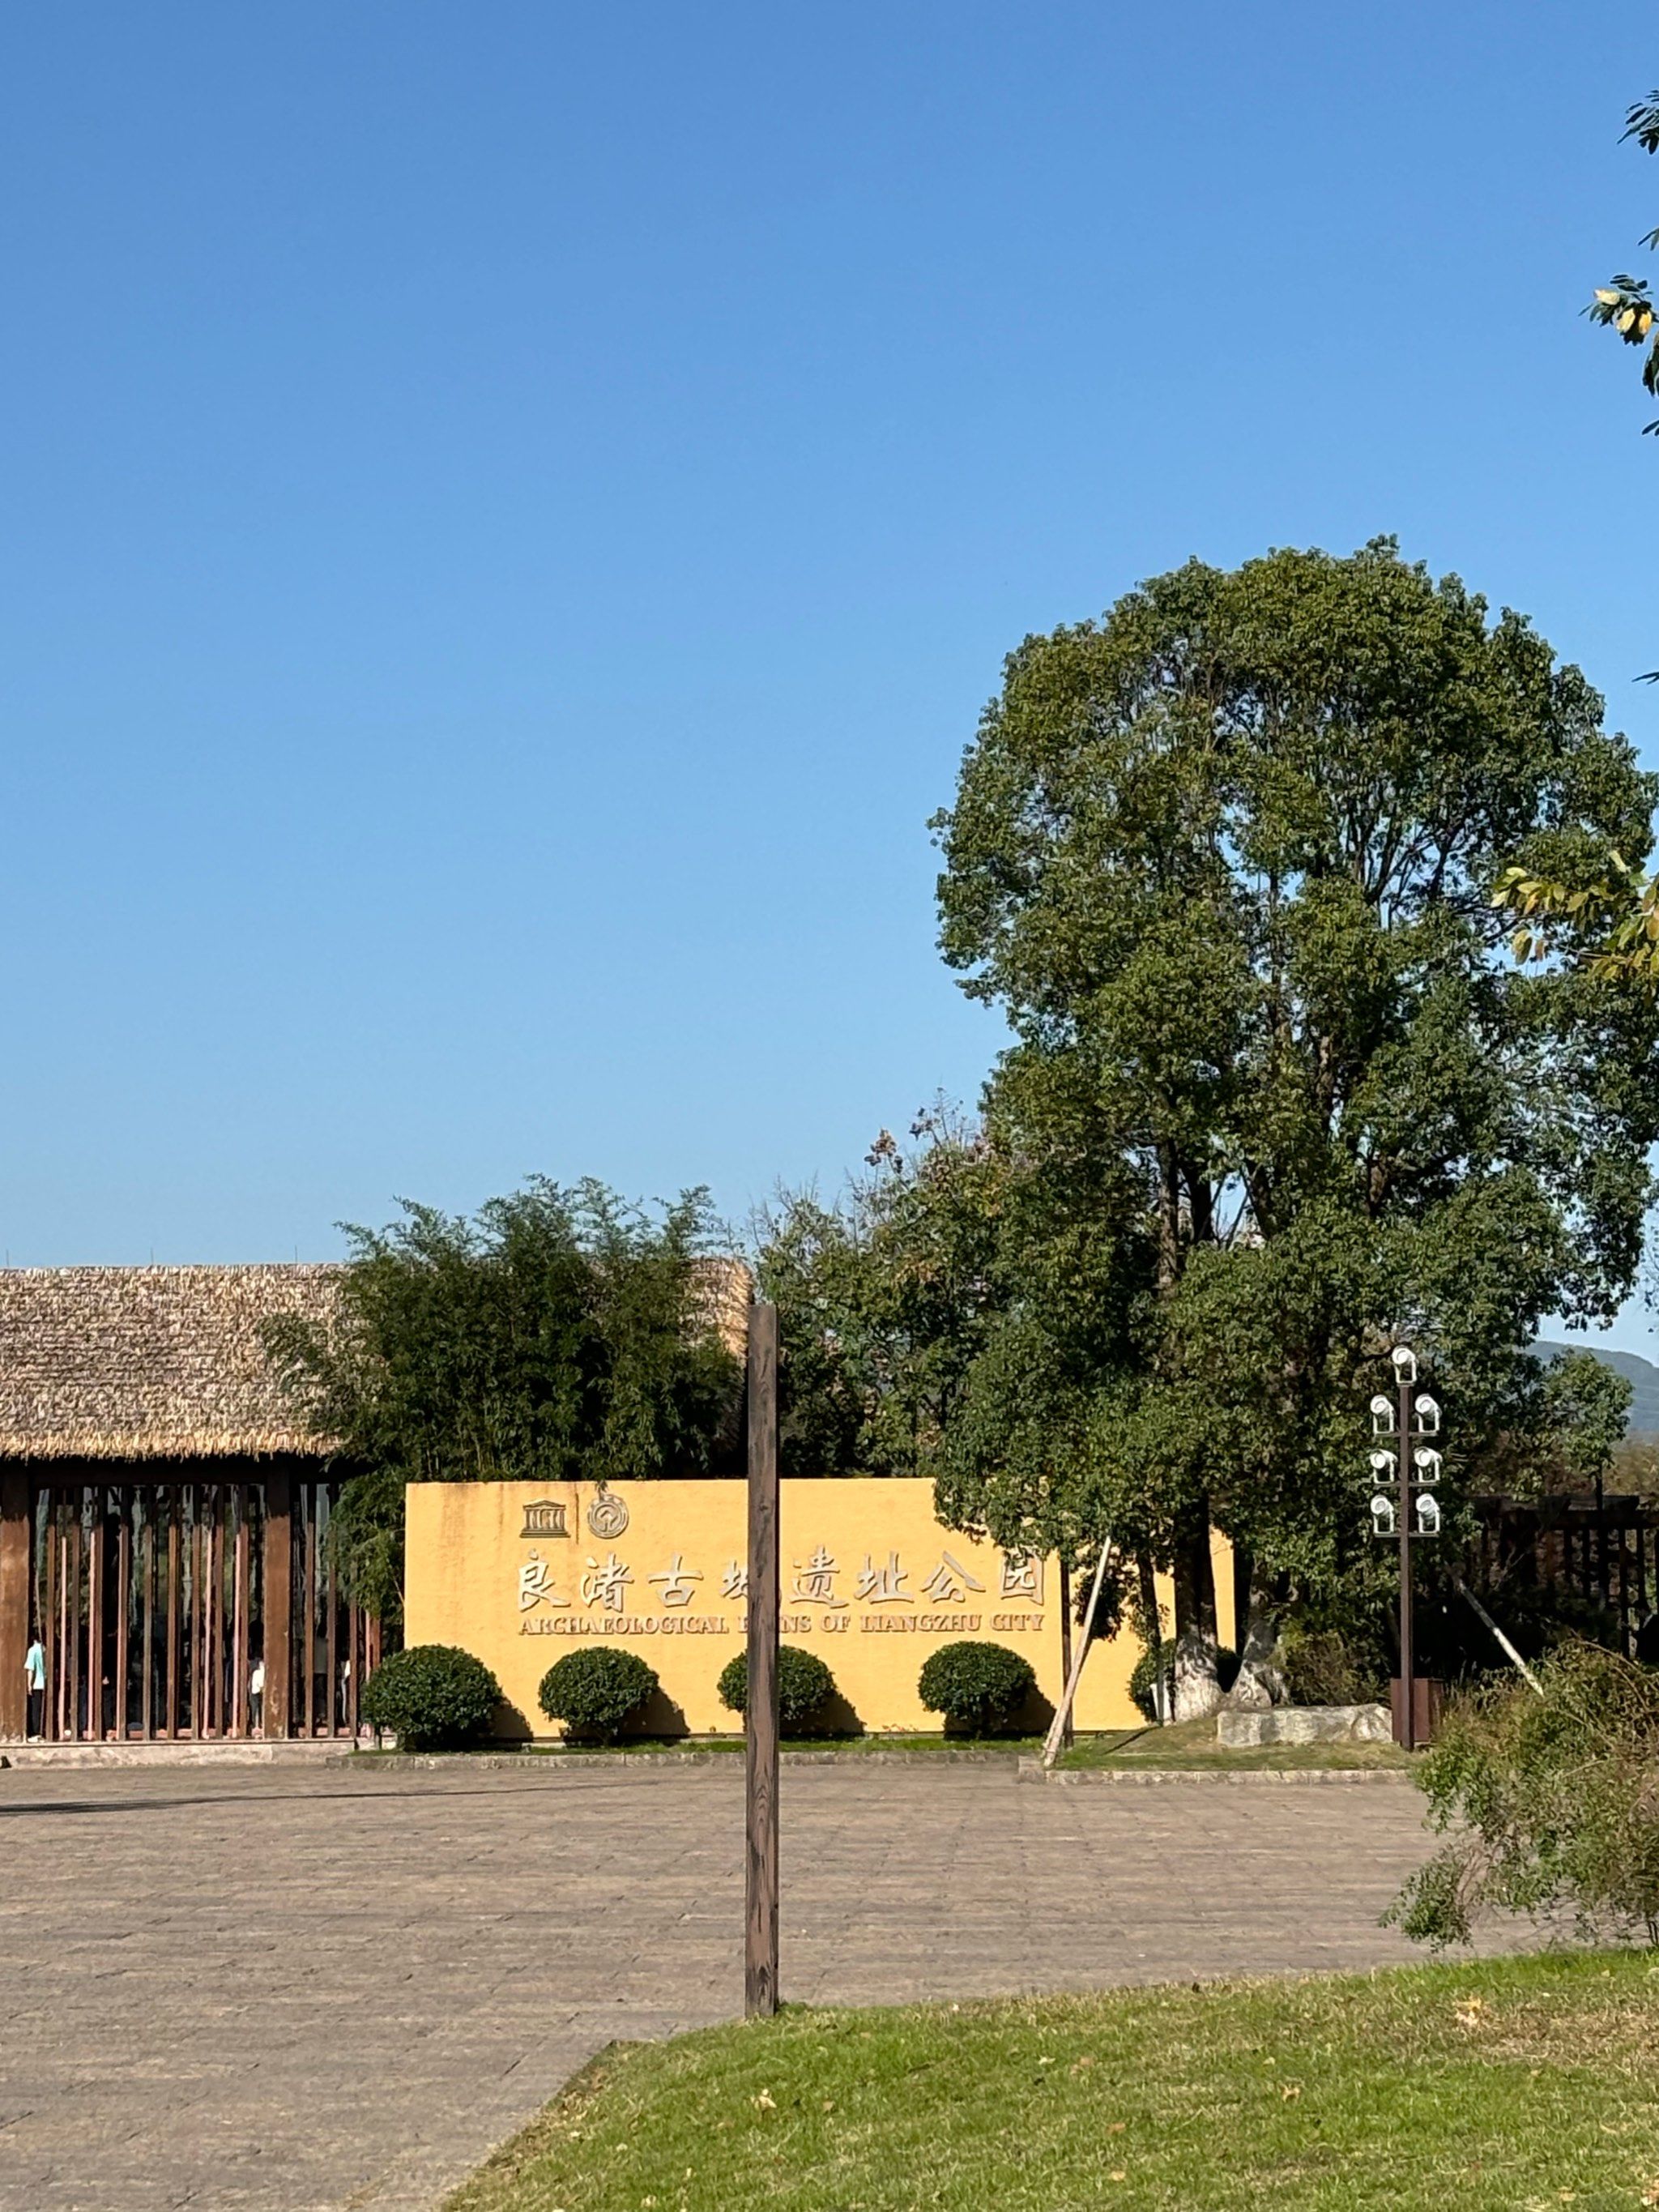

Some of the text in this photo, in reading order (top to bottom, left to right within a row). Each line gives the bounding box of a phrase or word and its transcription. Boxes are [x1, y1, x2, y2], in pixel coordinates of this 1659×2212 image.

[518, 1616, 729, 1635] ARCHAEOLOGICAL
[820, 1614, 851, 1633] OF
[860, 1614, 983, 1633] LIANGZHU
[991, 1613, 1045, 1632] CITY
